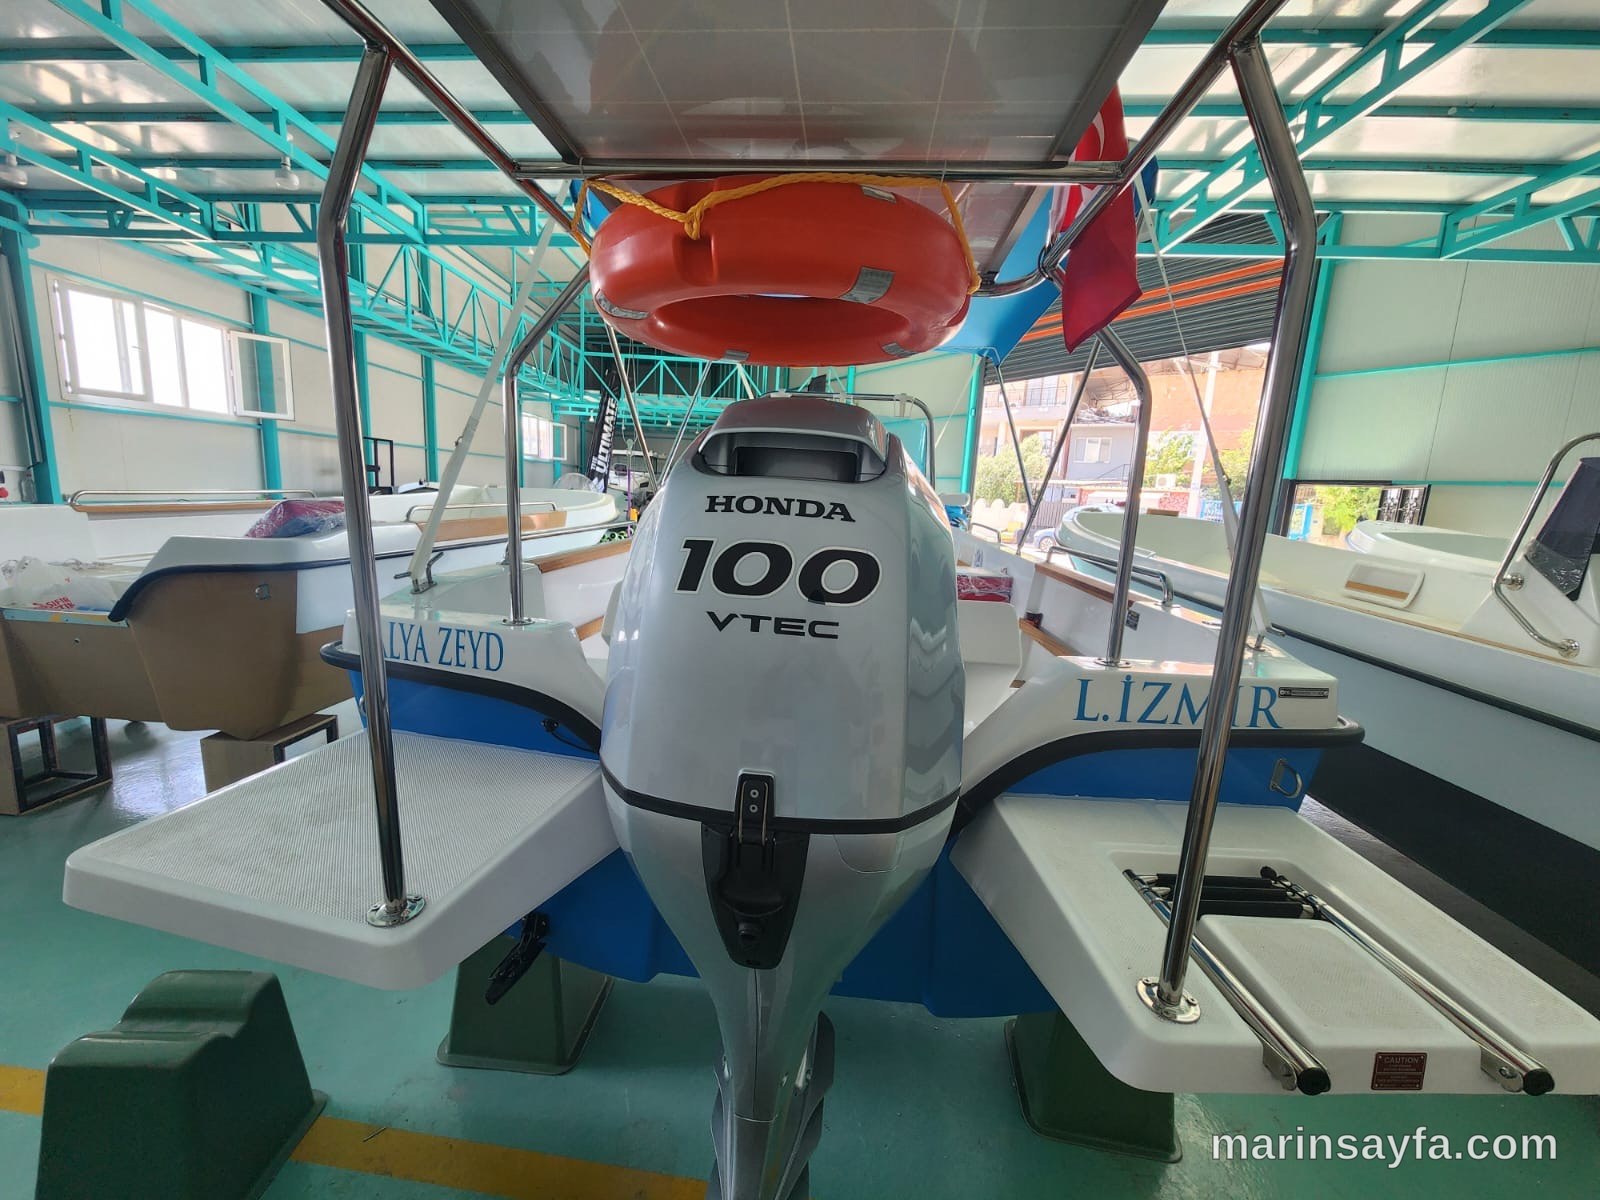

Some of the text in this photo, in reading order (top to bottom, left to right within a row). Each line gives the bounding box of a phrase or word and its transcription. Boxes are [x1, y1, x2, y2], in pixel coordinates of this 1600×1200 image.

[704, 494, 856, 523] HONDA
[674, 537, 882, 607] 100
[706, 610, 840, 640] VTEC
[382, 621, 504, 672] LYA ZEYD
[1383, 1056, 1420, 1064] CAUTION
